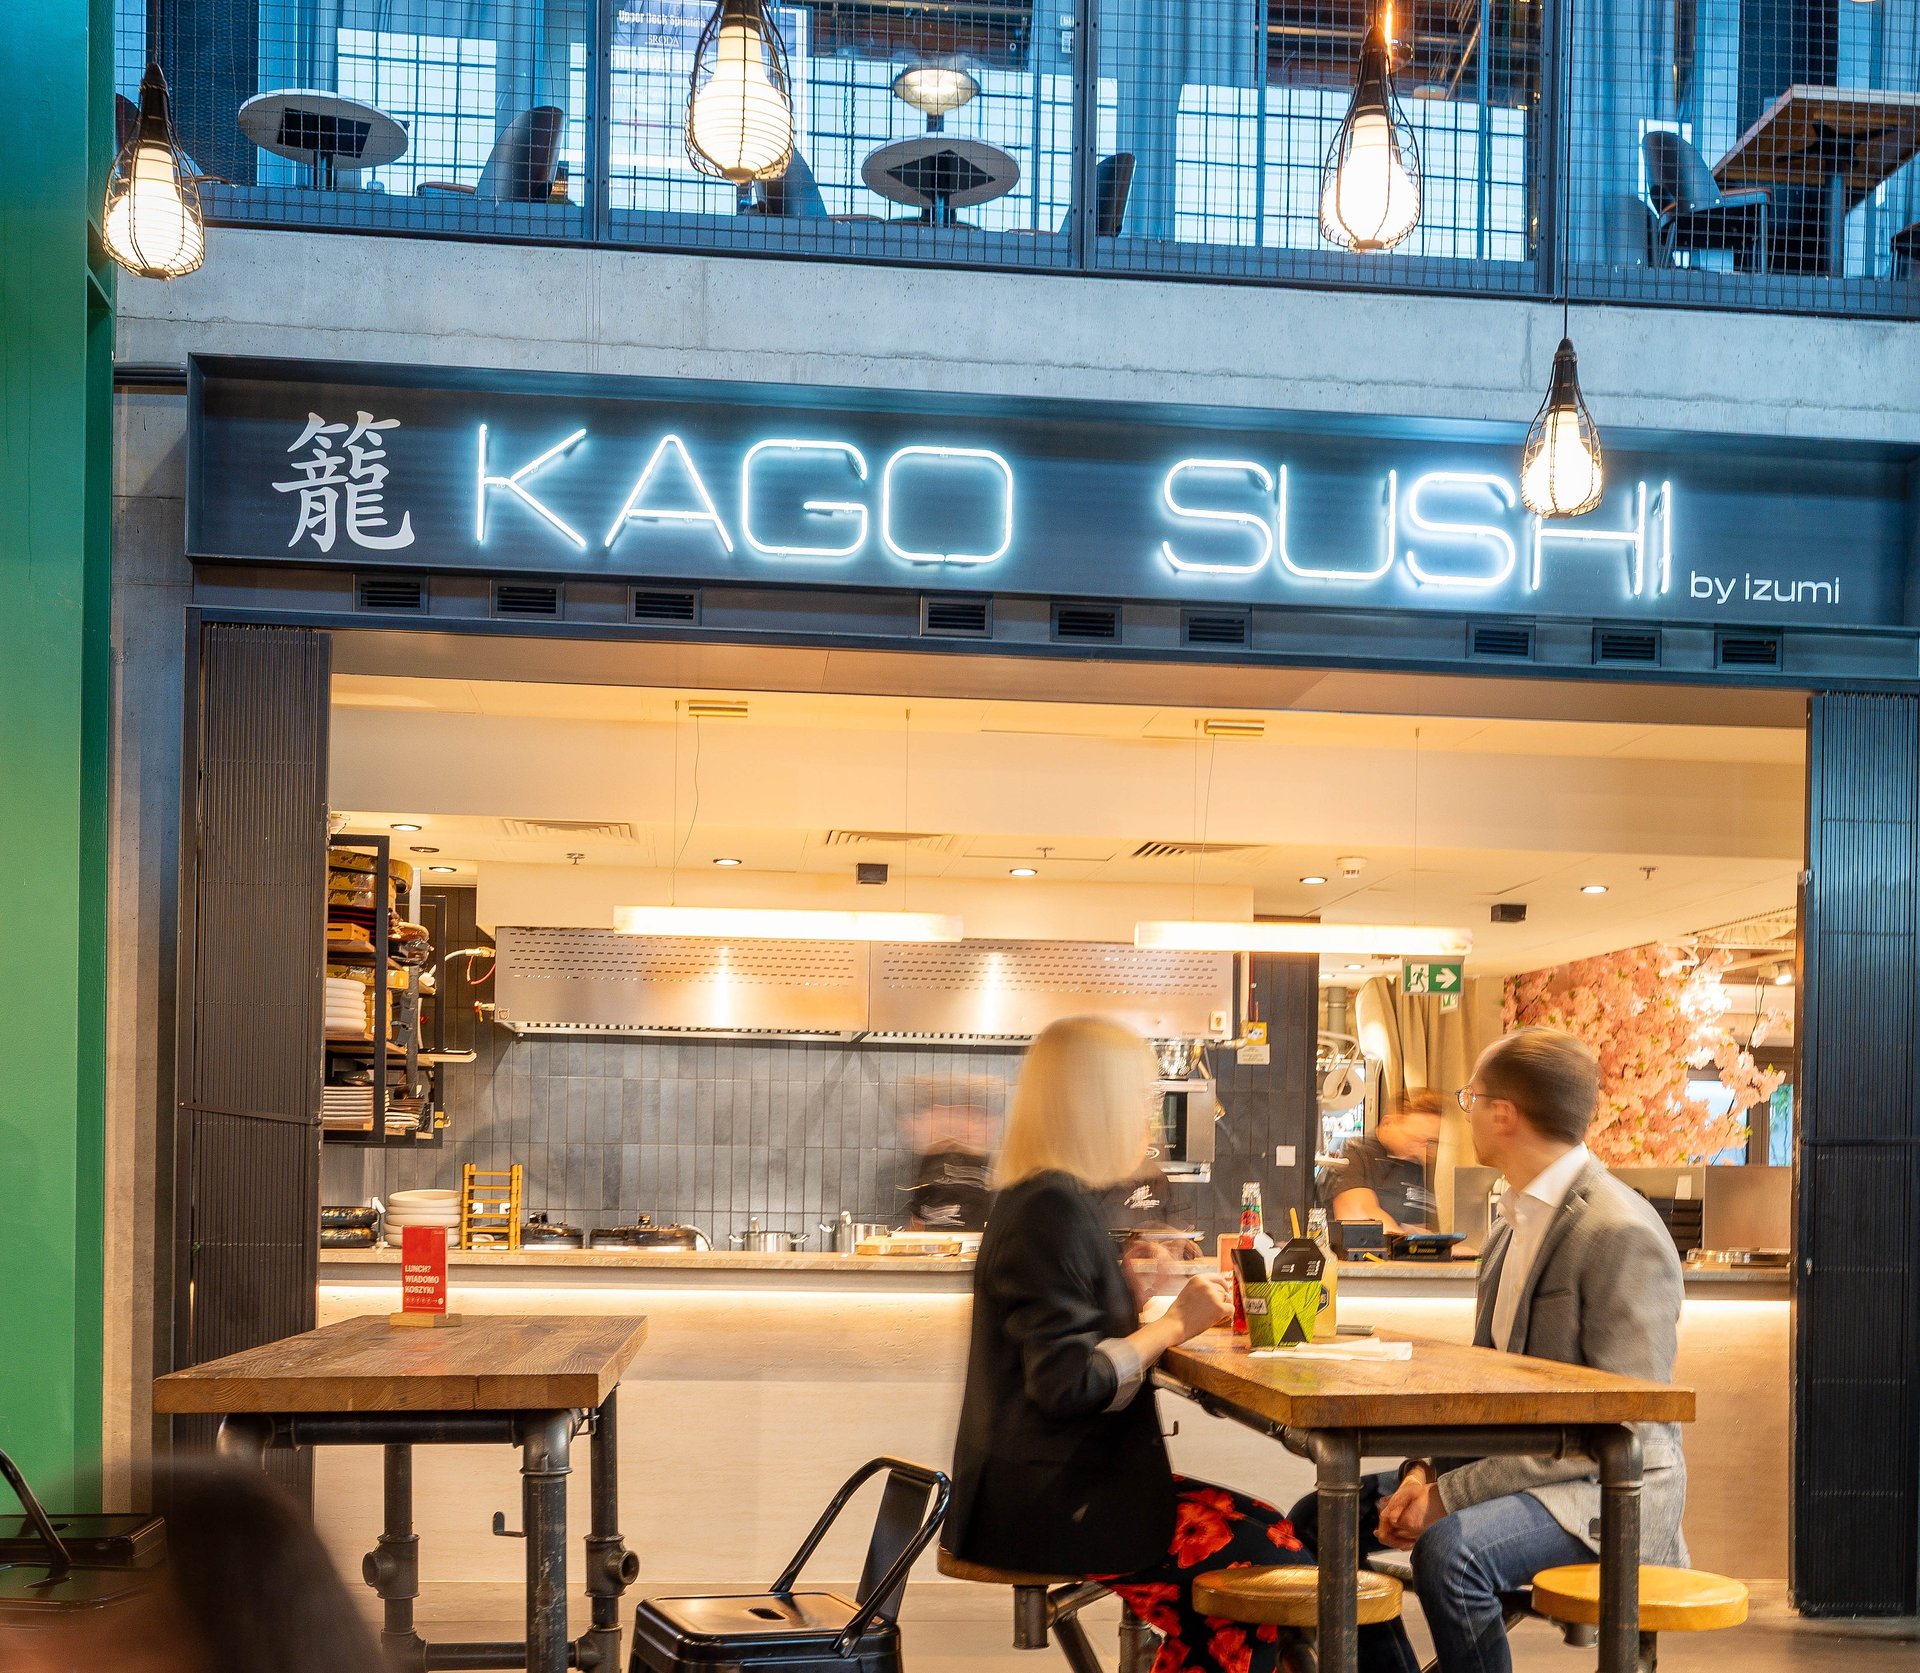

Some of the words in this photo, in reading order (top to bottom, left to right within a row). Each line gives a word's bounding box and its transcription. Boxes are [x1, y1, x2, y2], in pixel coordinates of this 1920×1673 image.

[271, 410, 415, 553] 籠
[476, 423, 1013, 564] KAGO
[1161, 458, 1671, 596] SUSHI
[1690, 570, 1737, 605] by
[1744, 572, 1840, 604] izumi
[405, 1265, 431, 1273] LUNCH?
[405, 1275, 439, 1284] WIADOMO
[405, 1286, 434, 1294] KOSZYKI
